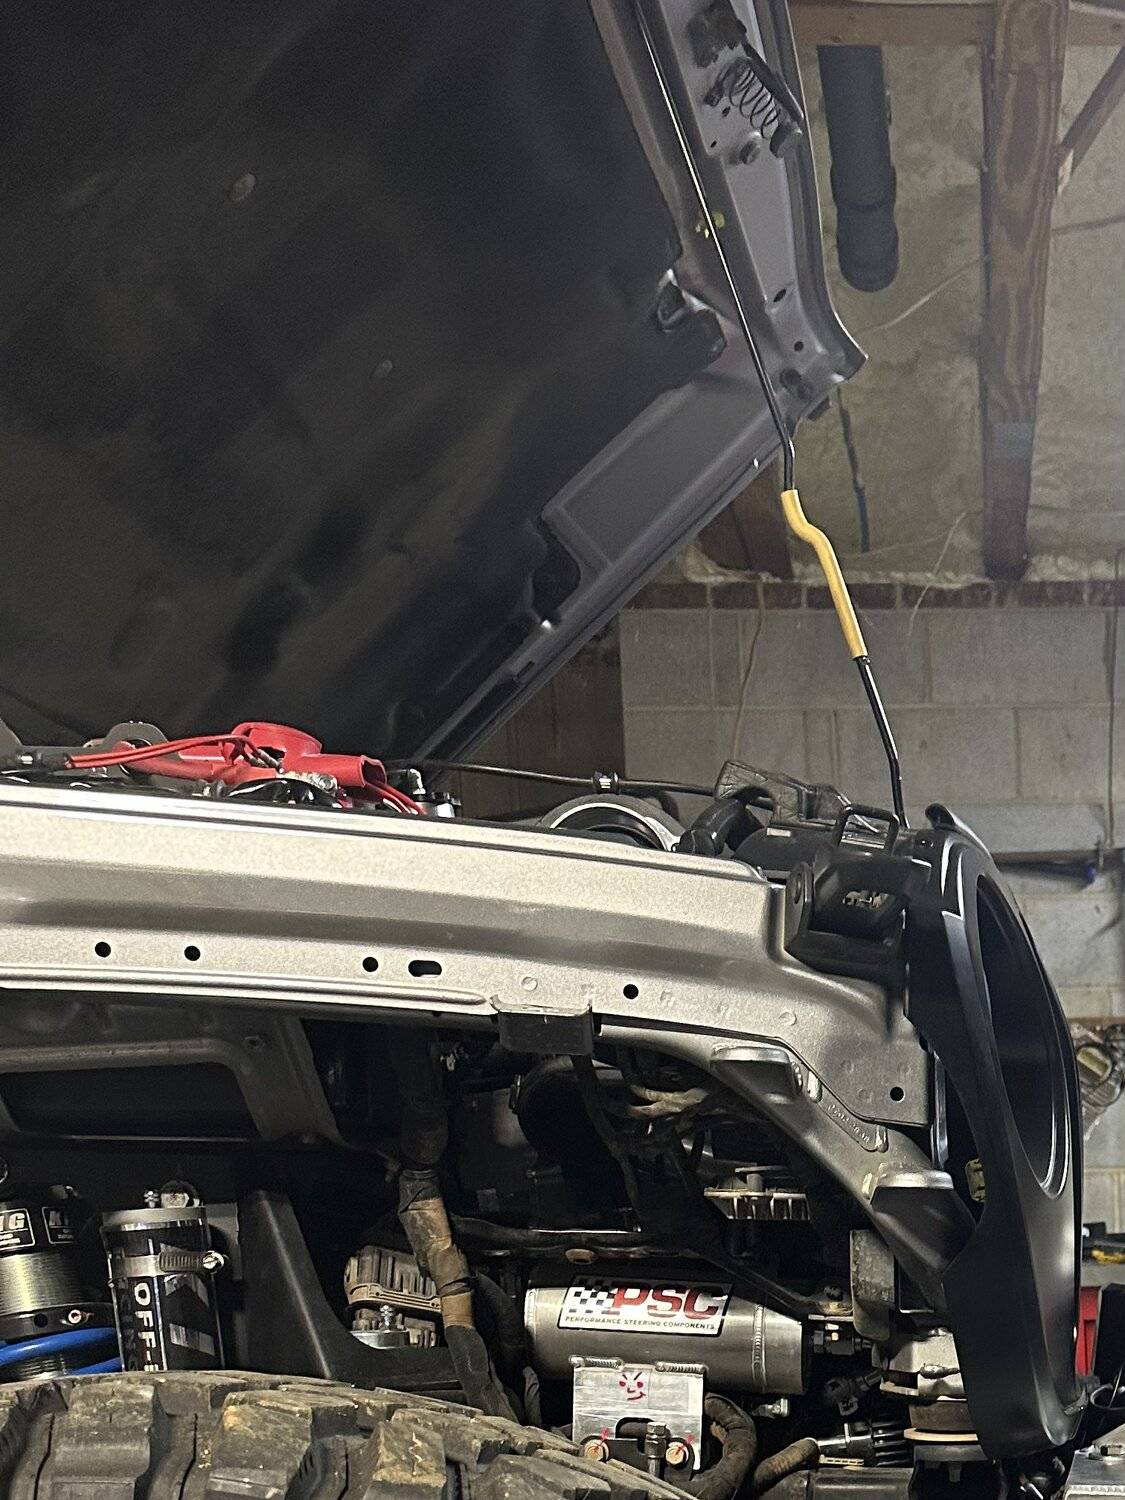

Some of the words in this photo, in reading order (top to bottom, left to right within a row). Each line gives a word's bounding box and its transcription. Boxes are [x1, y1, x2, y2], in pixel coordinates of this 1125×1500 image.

[609, 1281, 723, 1320] PSC
[565, 1315, 621, 1325] PERFORMANCE
[624, 1319, 661, 1327] STEERING
